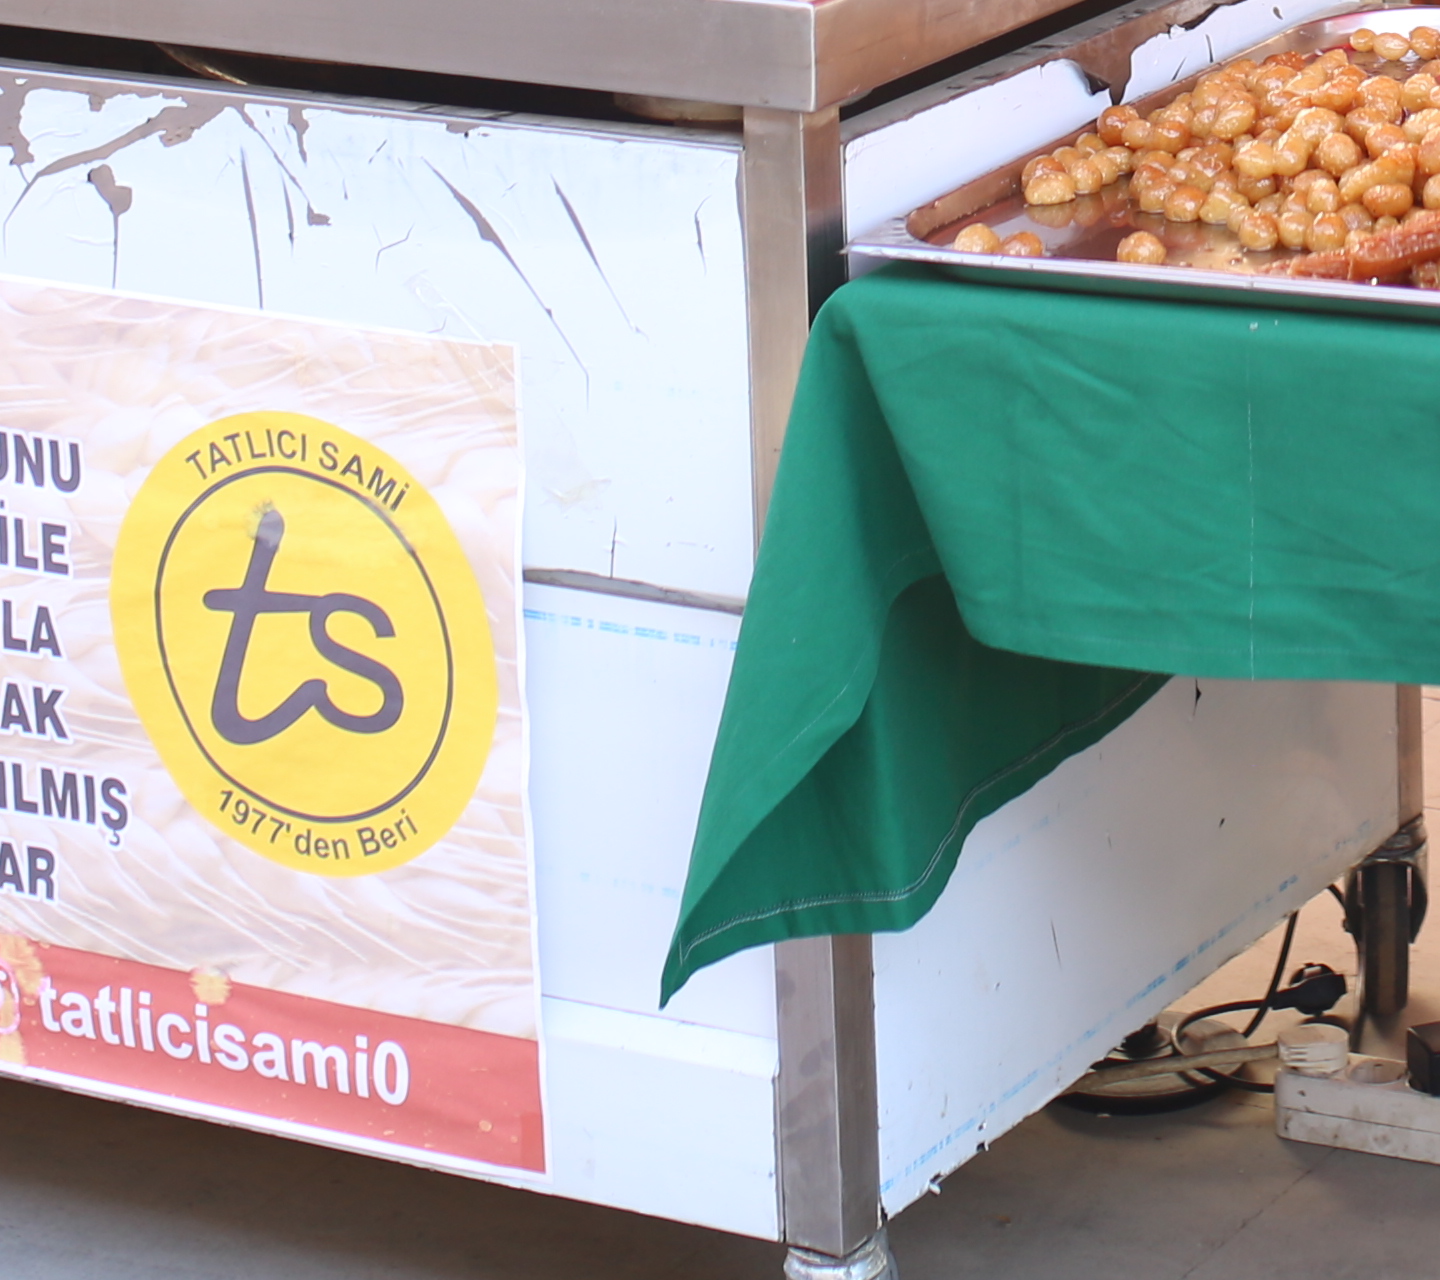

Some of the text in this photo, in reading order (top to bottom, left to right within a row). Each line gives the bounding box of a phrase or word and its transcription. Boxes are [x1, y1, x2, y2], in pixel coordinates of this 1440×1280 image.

[185, 428, 307, 480] TATLICI
[356, 808, 418, 858] Beri
[38, 976, 409, 1107] tatlicisami0
